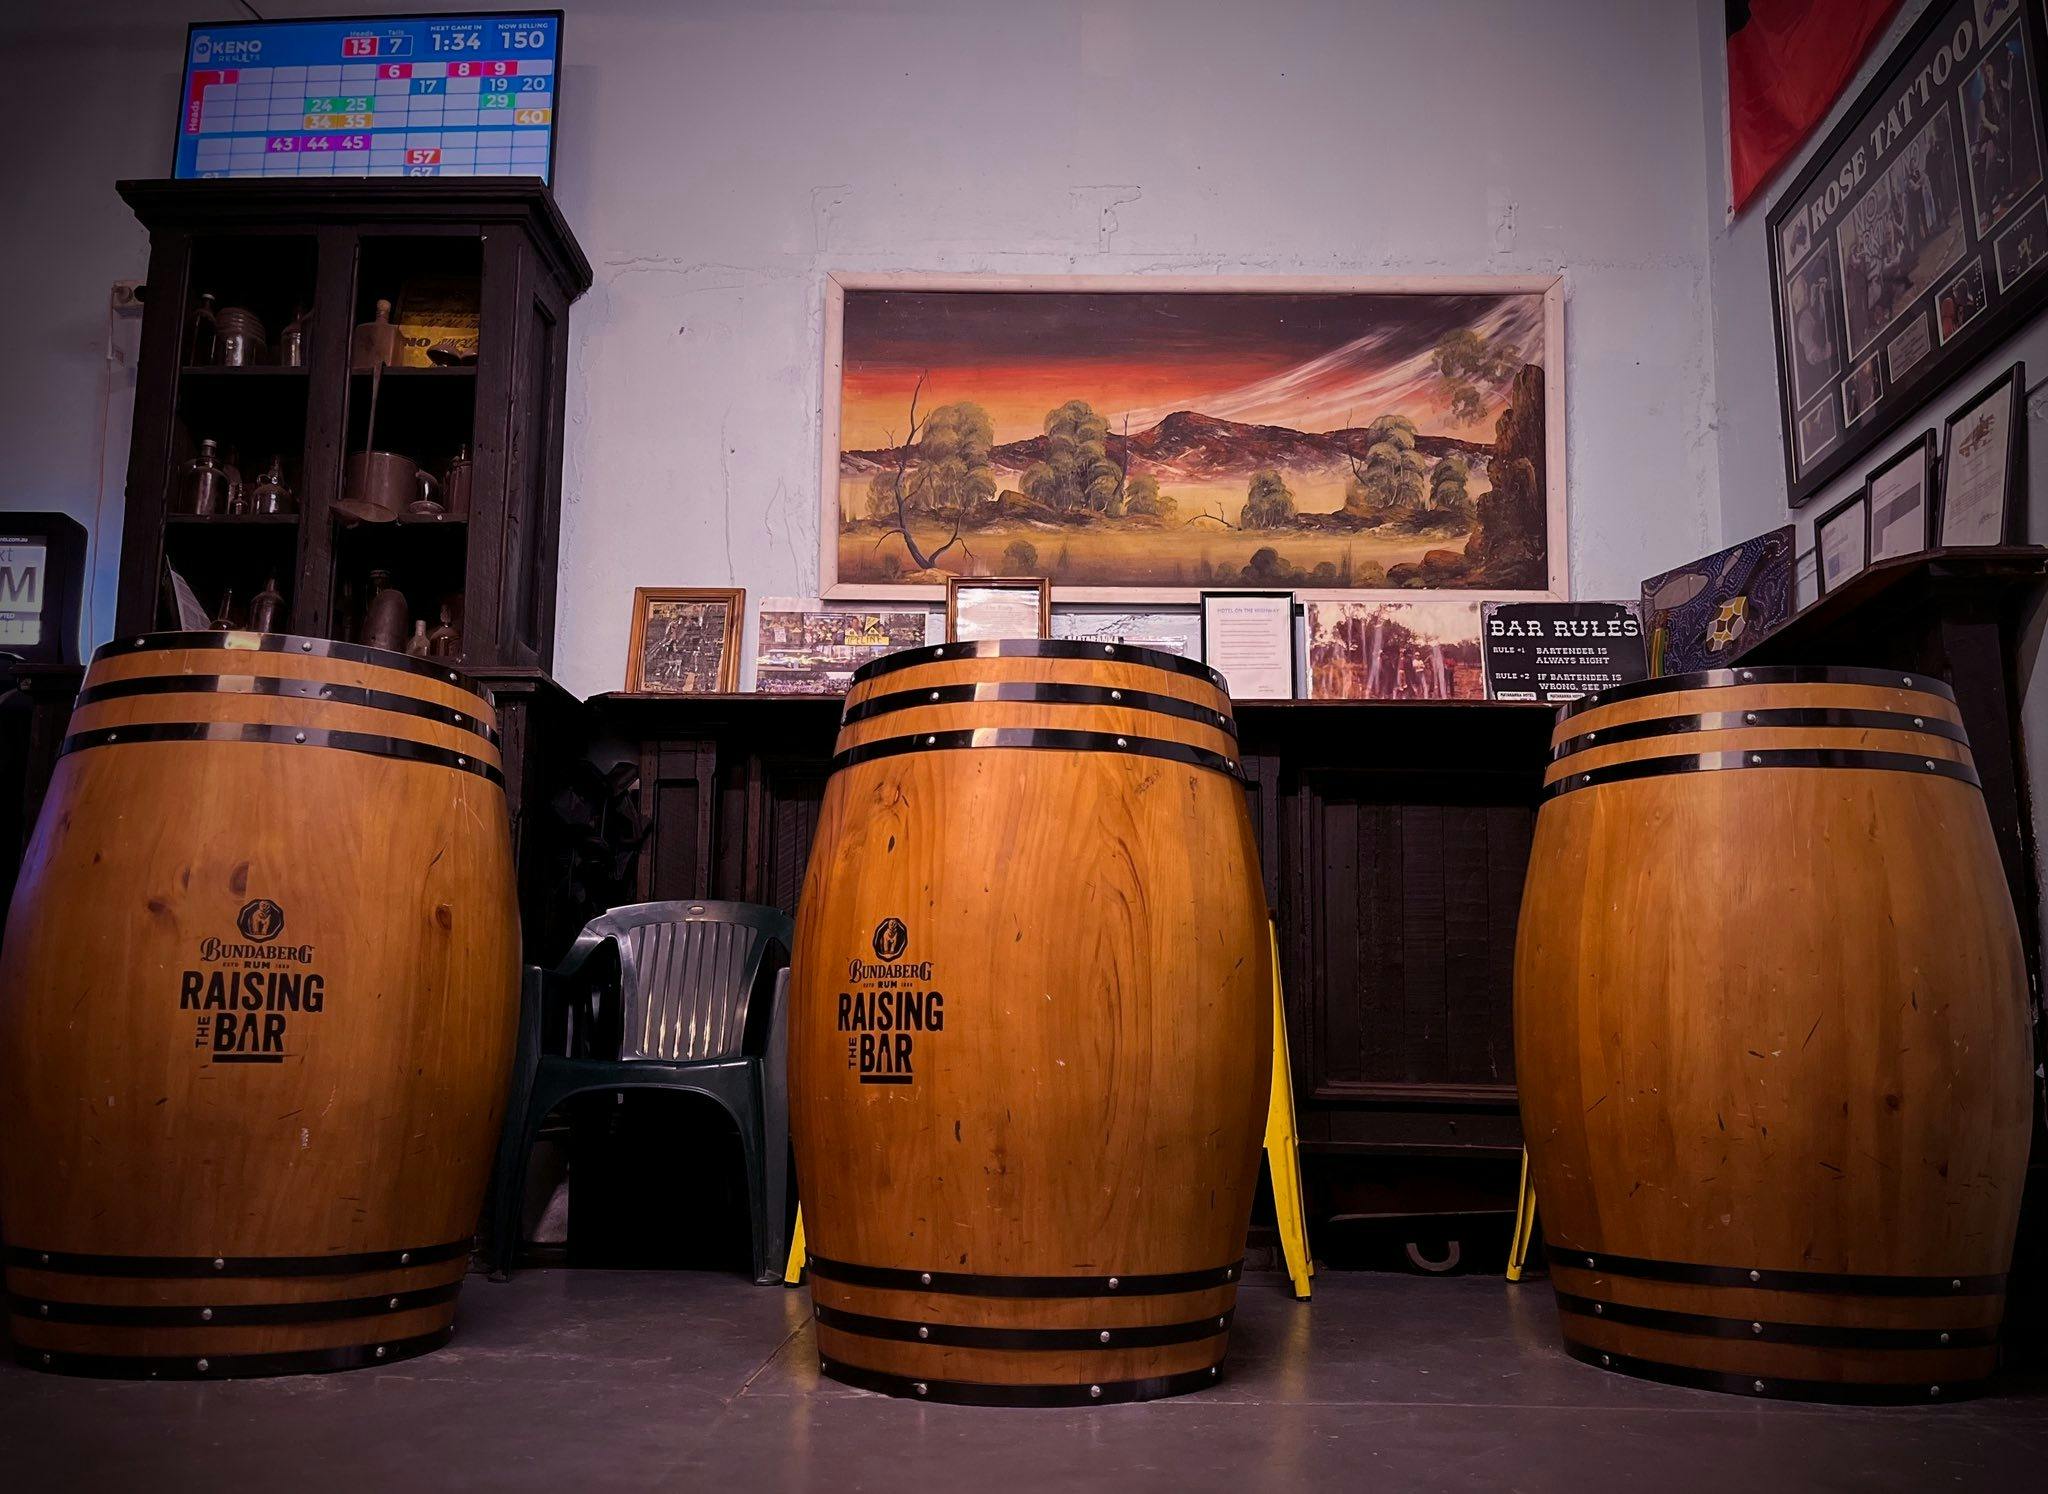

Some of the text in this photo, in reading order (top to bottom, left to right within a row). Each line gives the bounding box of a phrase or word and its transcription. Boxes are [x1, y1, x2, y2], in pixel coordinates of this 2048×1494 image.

[388, 29, 404, 37] Tails
[502, 31, 545, 49] 150
[213, 40, 262, 54] KENO
[351, 38, 371, 55] 13
[390, 38, 402, 54] 7
[432, 32, 481, 51] 1:34
[388, 64, 400, 78] 6
[458, 62, 470, 76] 8
[494, 62, 506, 75] 9
[217, 71, 224, 84] 1
[522, 77, 546, 91] 20
[419, 79, 437, 94] 17
[489, 78, 508, 92] 19
[311, 99, 333, 112] 24
[345, 98, 367, 111] 25
[486, 94, 509, 108] 29
[188, 101, 200, 131] Heads
[310, 115, 331, 128] 34
[345, 114, 365, 128] 35
[520, 110, 544, 124] 40
[1811, 146, 1866, 235] ROSE
[1870, 20, 1973, 161] TATTOO
[271, 137, 293, 151] 43
[306, 136, 329, 150] 44
[341, 135, 364, 149] 45
[412, 149, 435, 164] 57
[1490, 620, 1638, 637] BAR RULES
[1493, 646, 1515, 654] RULE
[1536, 647, 1608, 655] BARTENDER IS
[1536, 657, 1610, 665] ALWAYS RIGHT
[1495, 672, 1517, 680] RULE
[1537, 673, 1622, 682] IF BARTENDER IS
[1581, 683, 1600, 691] SEE
[243, 961, 271, 970] RUM
[180, 970, 325, 1013] RAISING
[877, 980, 898, 989] RUM
[837, 991, 944, 1032] RAISING
[195, 1015, 211, 1049] THE
[213, 1012, 286, 1052] BAR
[848, 1037, 857, 1070] THE
[859, 1033, 913, 1073] BAR
